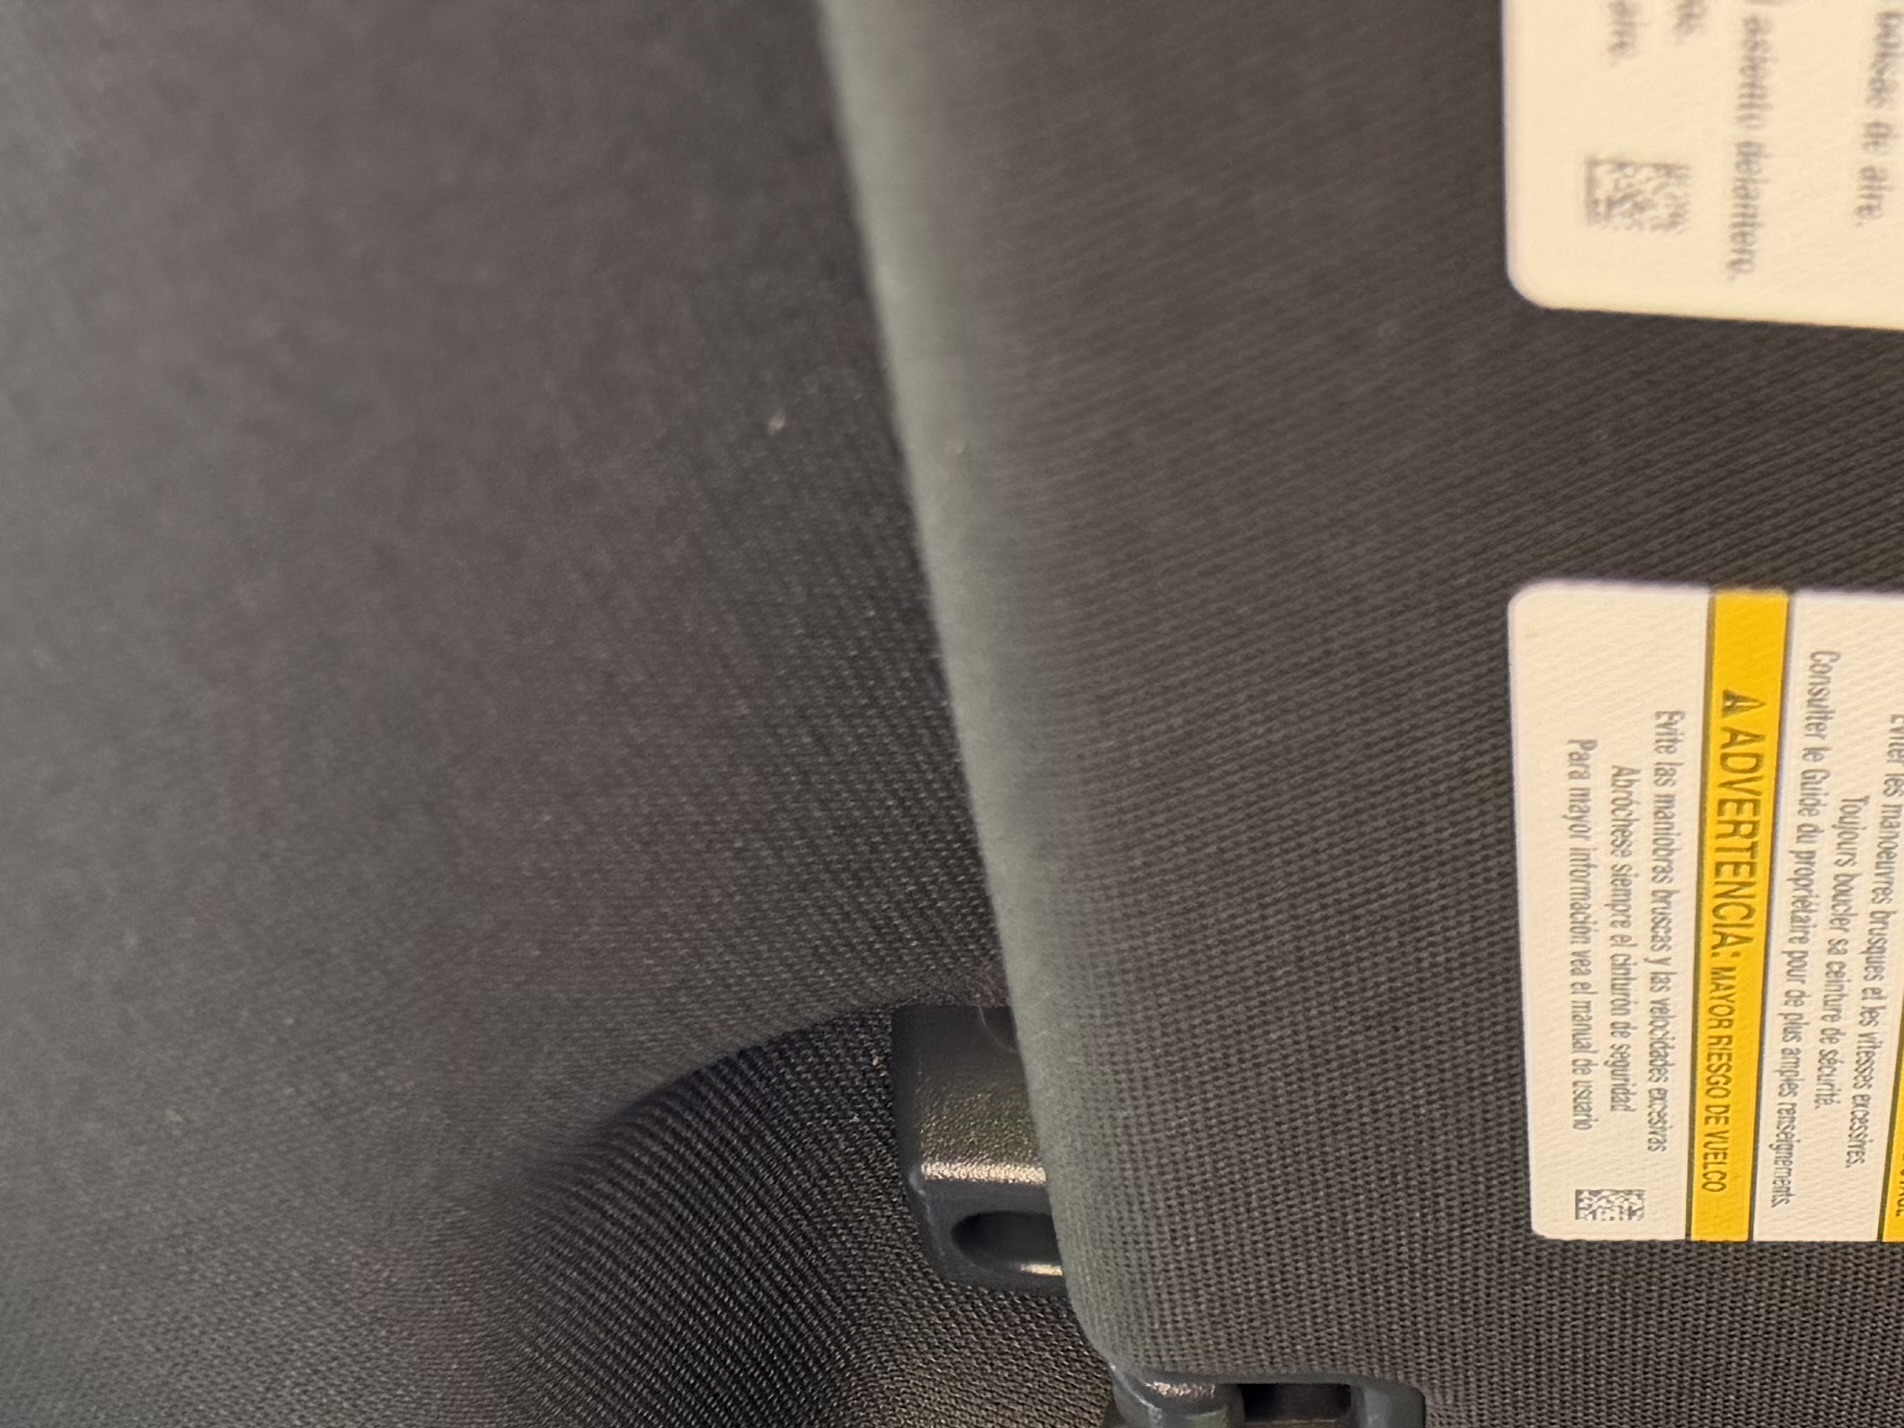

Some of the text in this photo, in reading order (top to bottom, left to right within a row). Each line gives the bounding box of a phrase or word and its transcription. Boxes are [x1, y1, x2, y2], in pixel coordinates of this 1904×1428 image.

[1803, 650, 1842, 740] Consulter
[1802, 747, 1833, 762] le
[1797, 769, 1832, 817] Guide
[1795, 823, 1825, 845] du
[1831, 795, 1870, 867] Toujours
[1870, 804, 1904, 904] manoeuvres
[1787, 849, 1820, 945] propriétaire
[1831, 873, 1863, 933] boucler
[1562, 739, 1600, 1130] Para mayor información vea el manual de usuario
[1604, 765, 1642, 1113] Abróchese siempre el cinturón de seguridad
[1644, 710, 1686, 1153] Evite las maniobras bruscas y las velocidades excesivas
[1702, 726, 1767, 1193] ADVERTENCIA: MAYOR RIESGO DE VUELCO
[1826, 938, 1847, 957] sa
[1860, 910, 1898, 981] brusques
[1782, 950, 1811, 982] pour
[1821, 961, 1851, 1023] ceinture
[1861, 987, 1888, 1001] et
[1778, 1012, 1810, 1042] plus
[1786, 990, 1812, 1008] de
[1858, 1006, 1887, 1027] les
[1819, 1028, 1848, 1044] de
[1852, 1032, 1884, 1089] vitesses
[1772, 1048, 1806, 1097] amples
